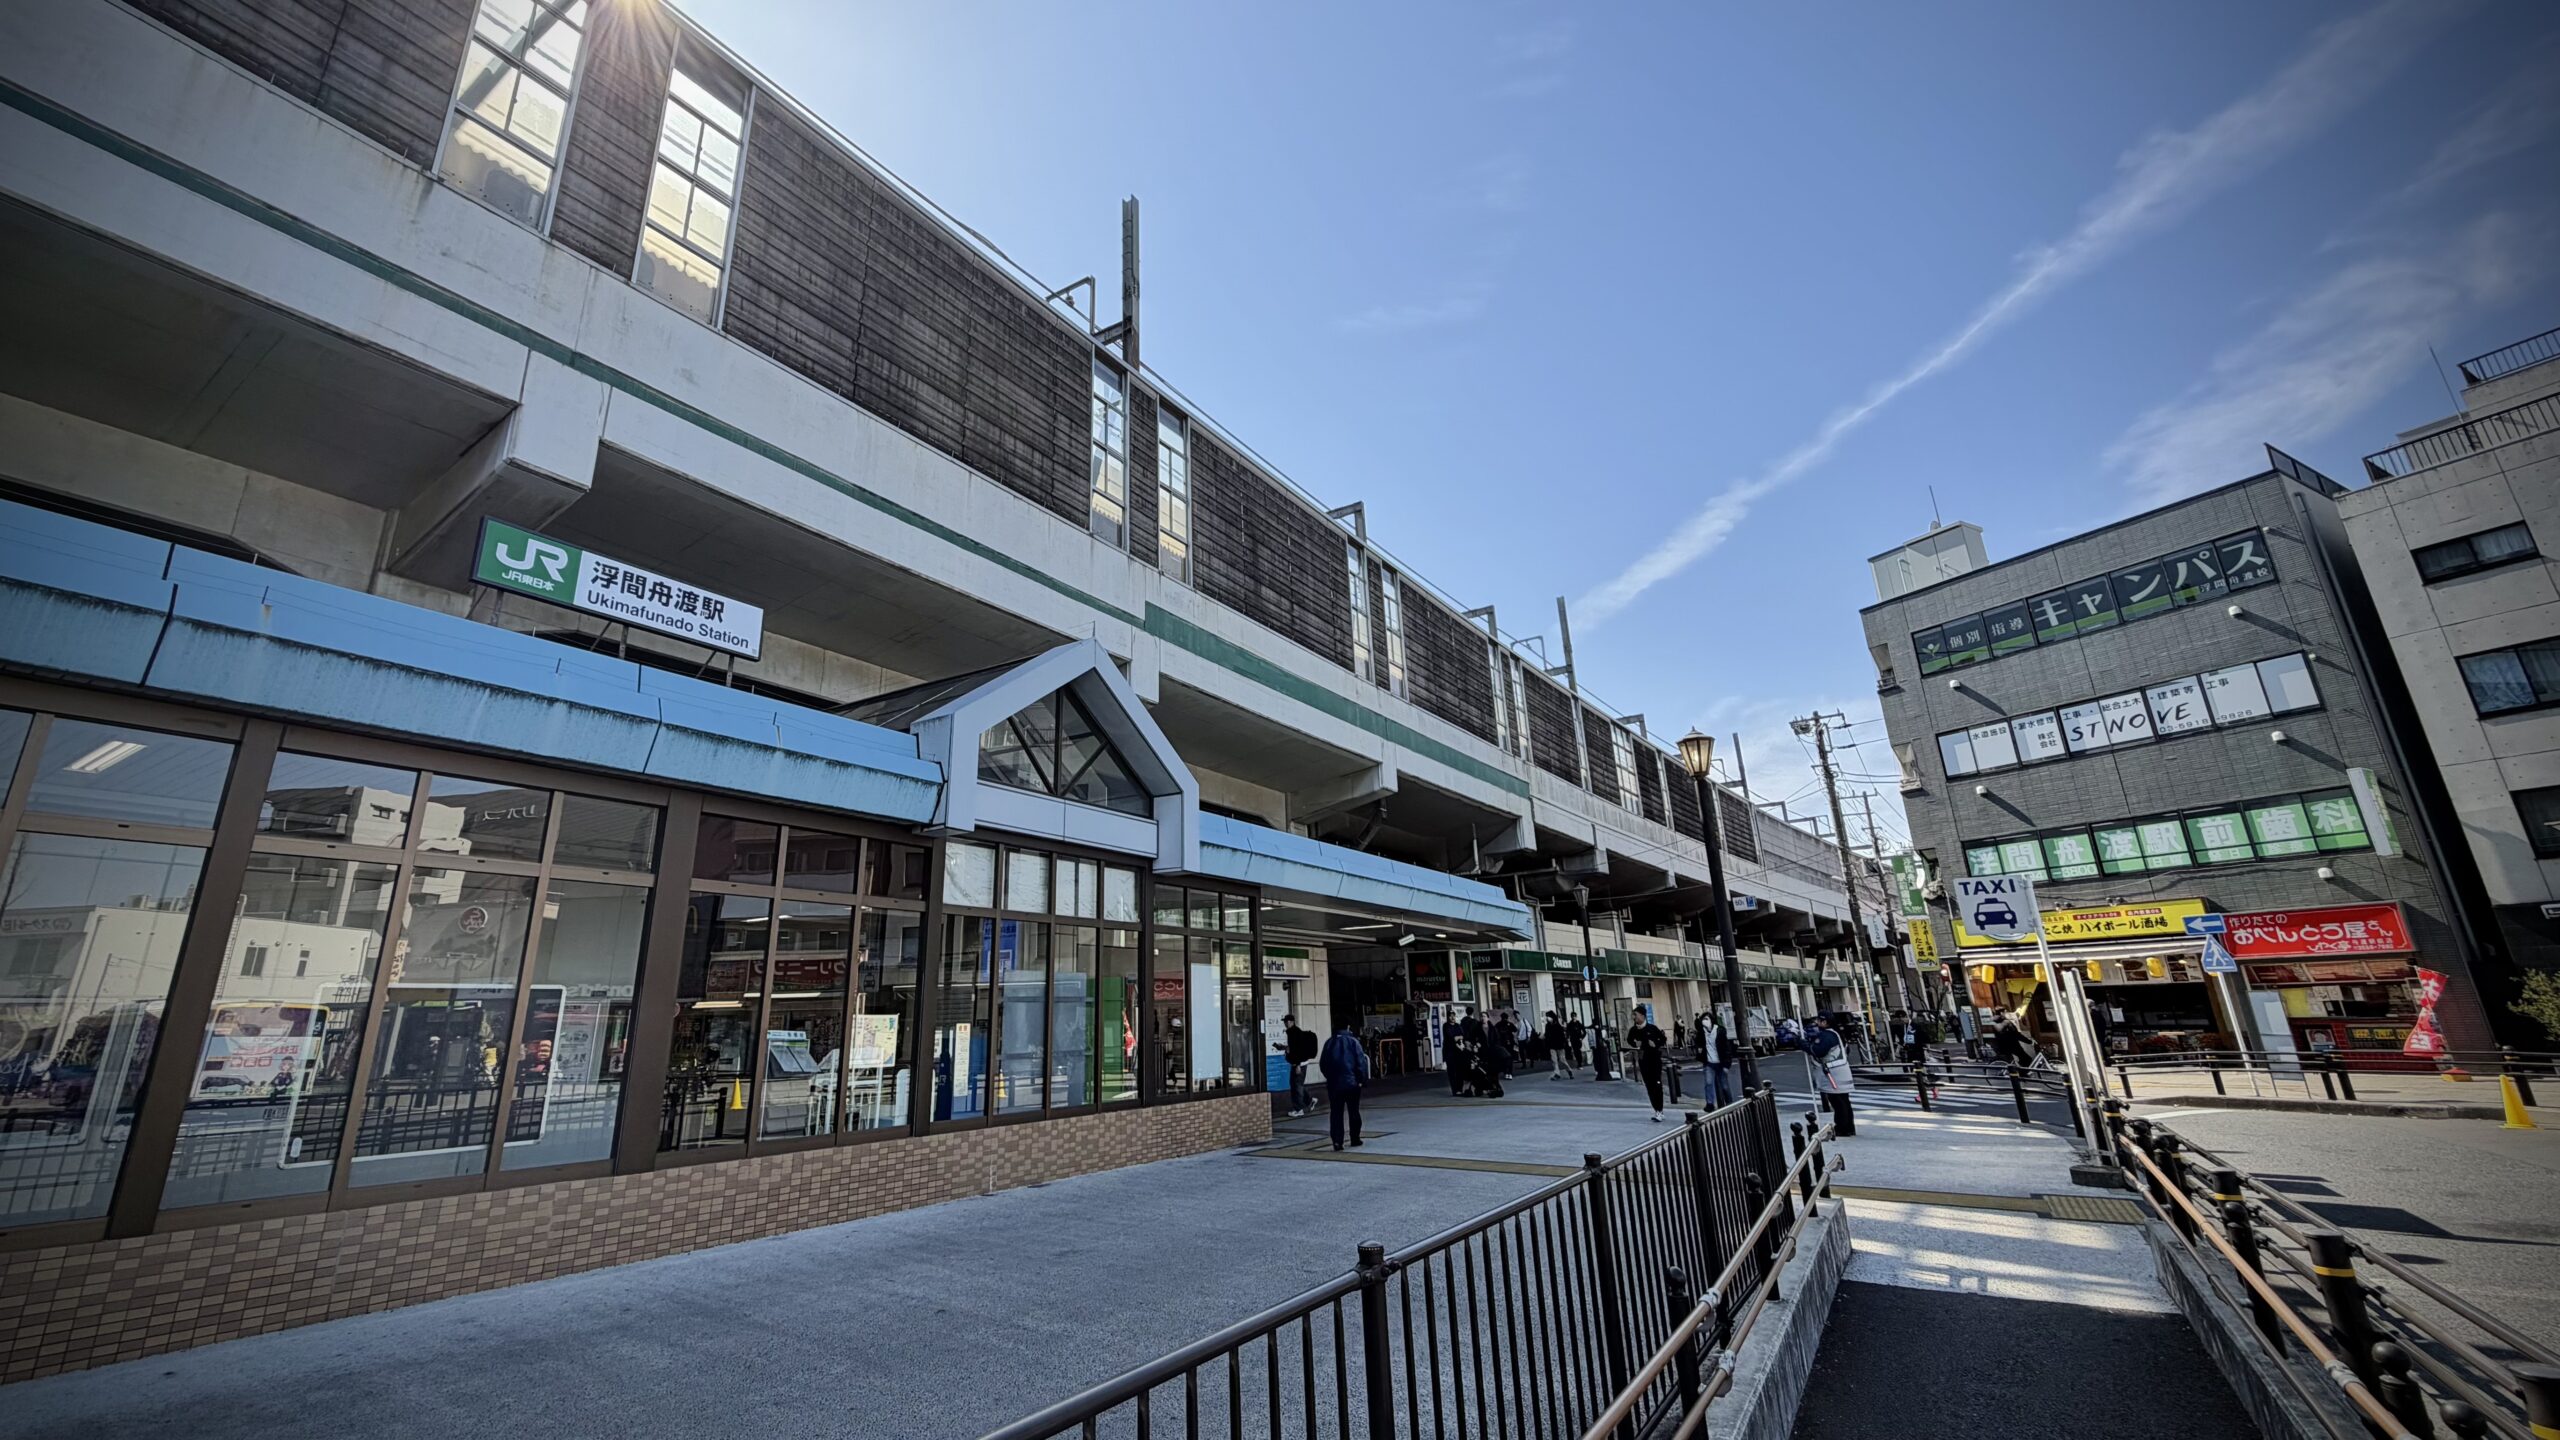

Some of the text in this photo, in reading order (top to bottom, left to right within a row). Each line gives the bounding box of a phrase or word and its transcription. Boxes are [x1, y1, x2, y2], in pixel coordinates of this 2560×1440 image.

[495, 537, 569, 583] JR
[501, 569, 555, 591] JR東日本
[590, 560, 725, 624] 浮間舟渡駅
[2034, 539, 2267, 627] キャンパス
[587, 589, 749, 649] Ukimafunado Station
[2037, 731, 2056, 740] 株式
[2040, 740, 2058, 748] 会社
[1970, 798, 2360, 878] 浮間舟渡駅前歯科
[1958, 878, 2017, 896] TAXI
[2080, 916, 2169, 934] ハイボール酒場
[2229, 913, 2288, 928] 作りたての
[2233, 919, 2393, 945] おべんとう屋さん
